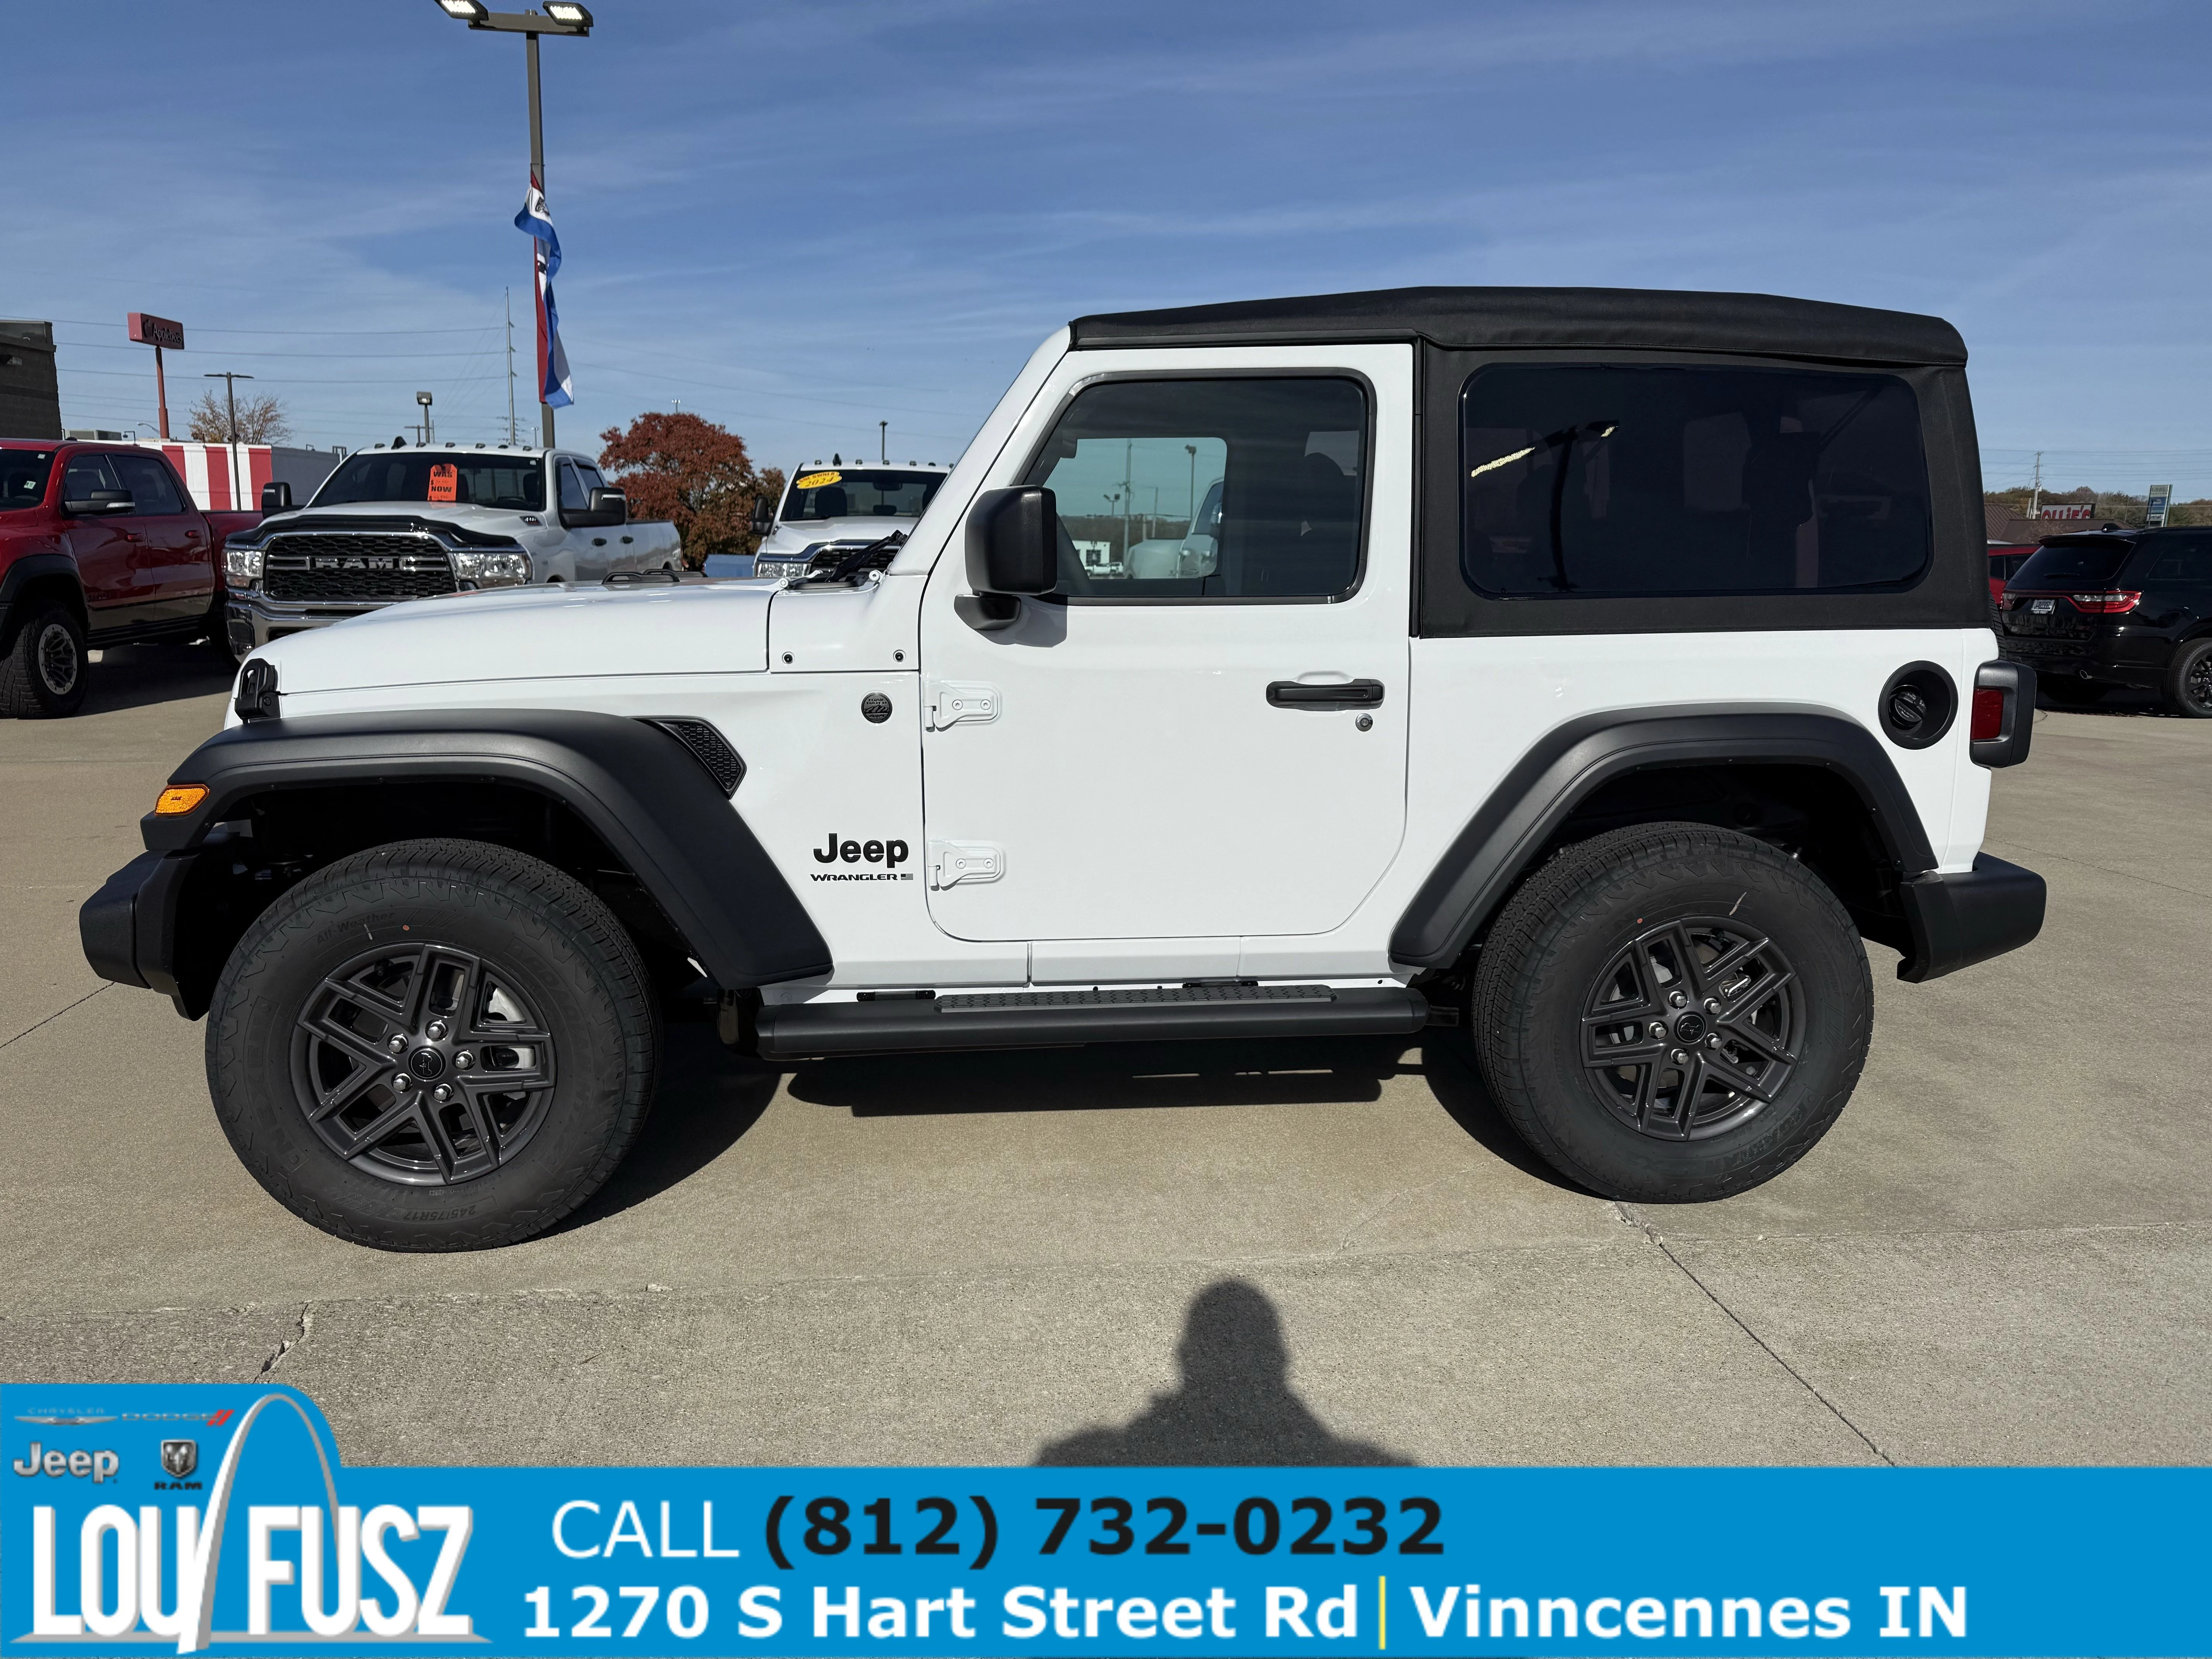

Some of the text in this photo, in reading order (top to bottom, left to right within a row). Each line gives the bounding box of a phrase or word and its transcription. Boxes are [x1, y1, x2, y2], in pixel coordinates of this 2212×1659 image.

[805, 476, 834, 487] 2024
[315, 558, 394, 569] RAM
[813, 833, 908, 868] Jeep
[312, 909, 396, 946] All-Weather
[402, 1204, 479, 1221] 245/75R17
